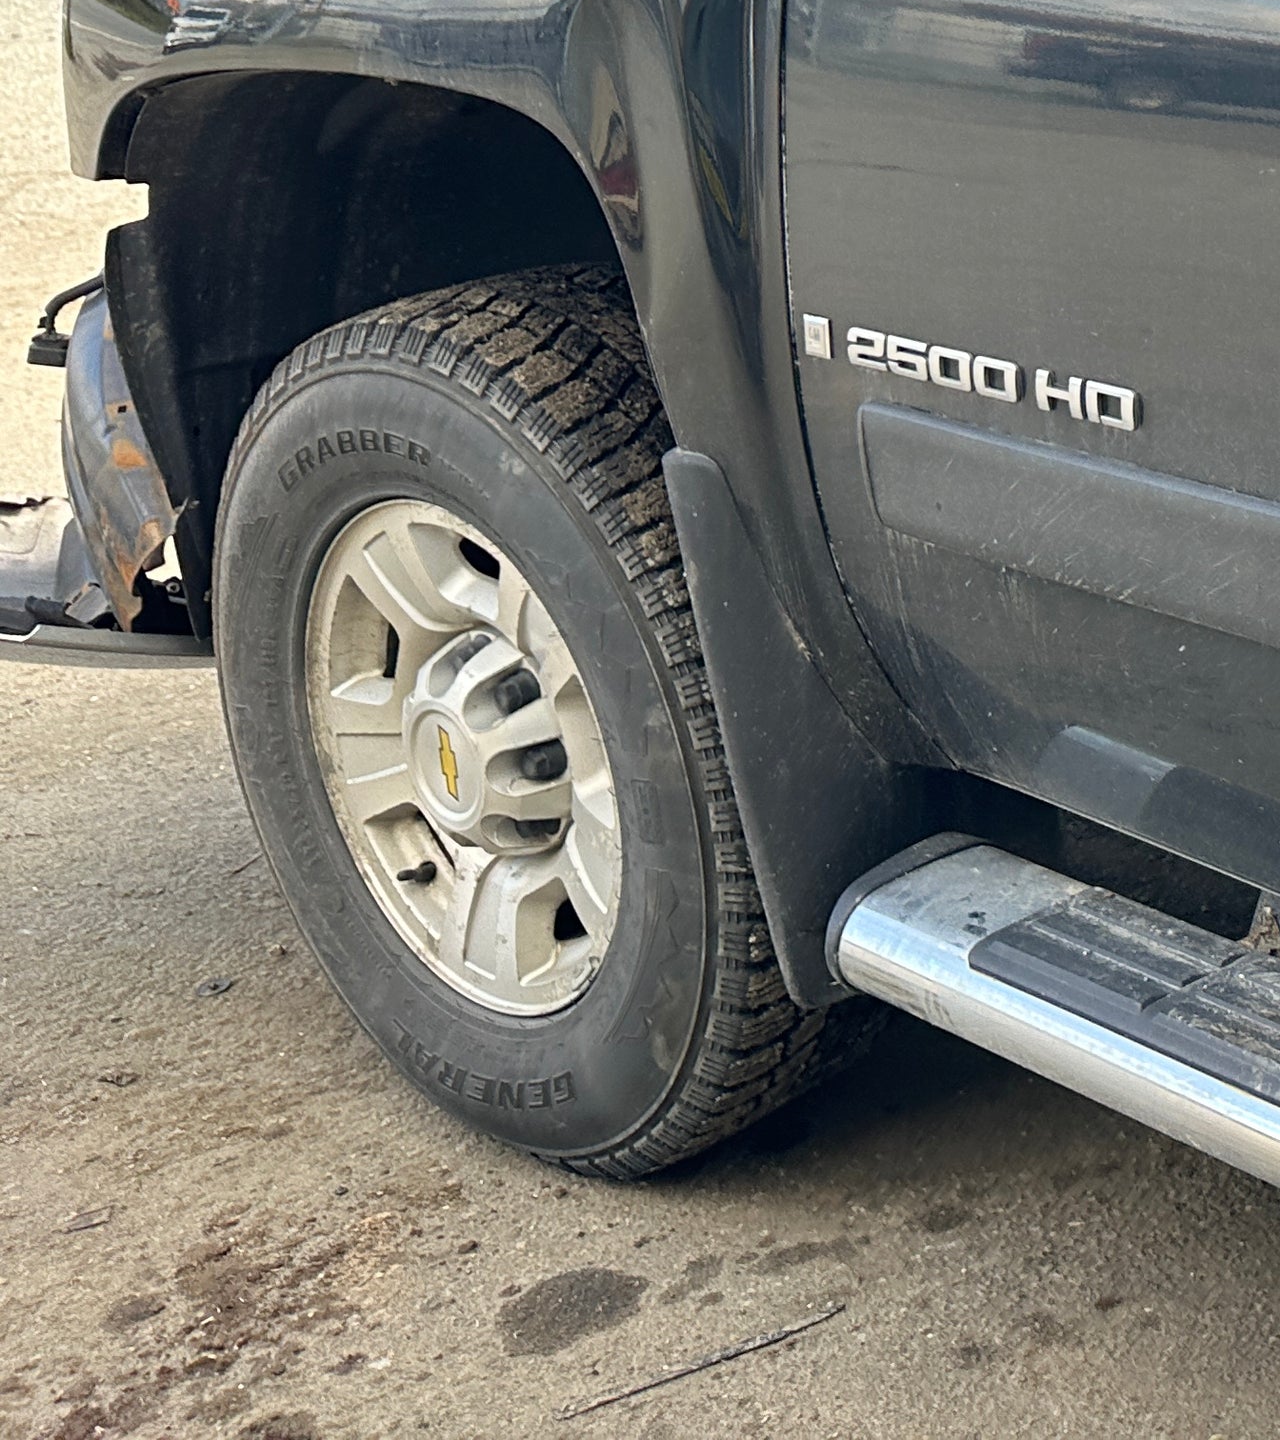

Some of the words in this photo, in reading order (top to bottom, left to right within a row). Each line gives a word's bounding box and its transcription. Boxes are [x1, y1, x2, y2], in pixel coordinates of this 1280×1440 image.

[847, 326, 1023, 403] 2500
[1035, 368, 1138, 432] HD
[276, 428, 432, 492] GRABBER
[392, 1017, 578, 1111] GENERAL
